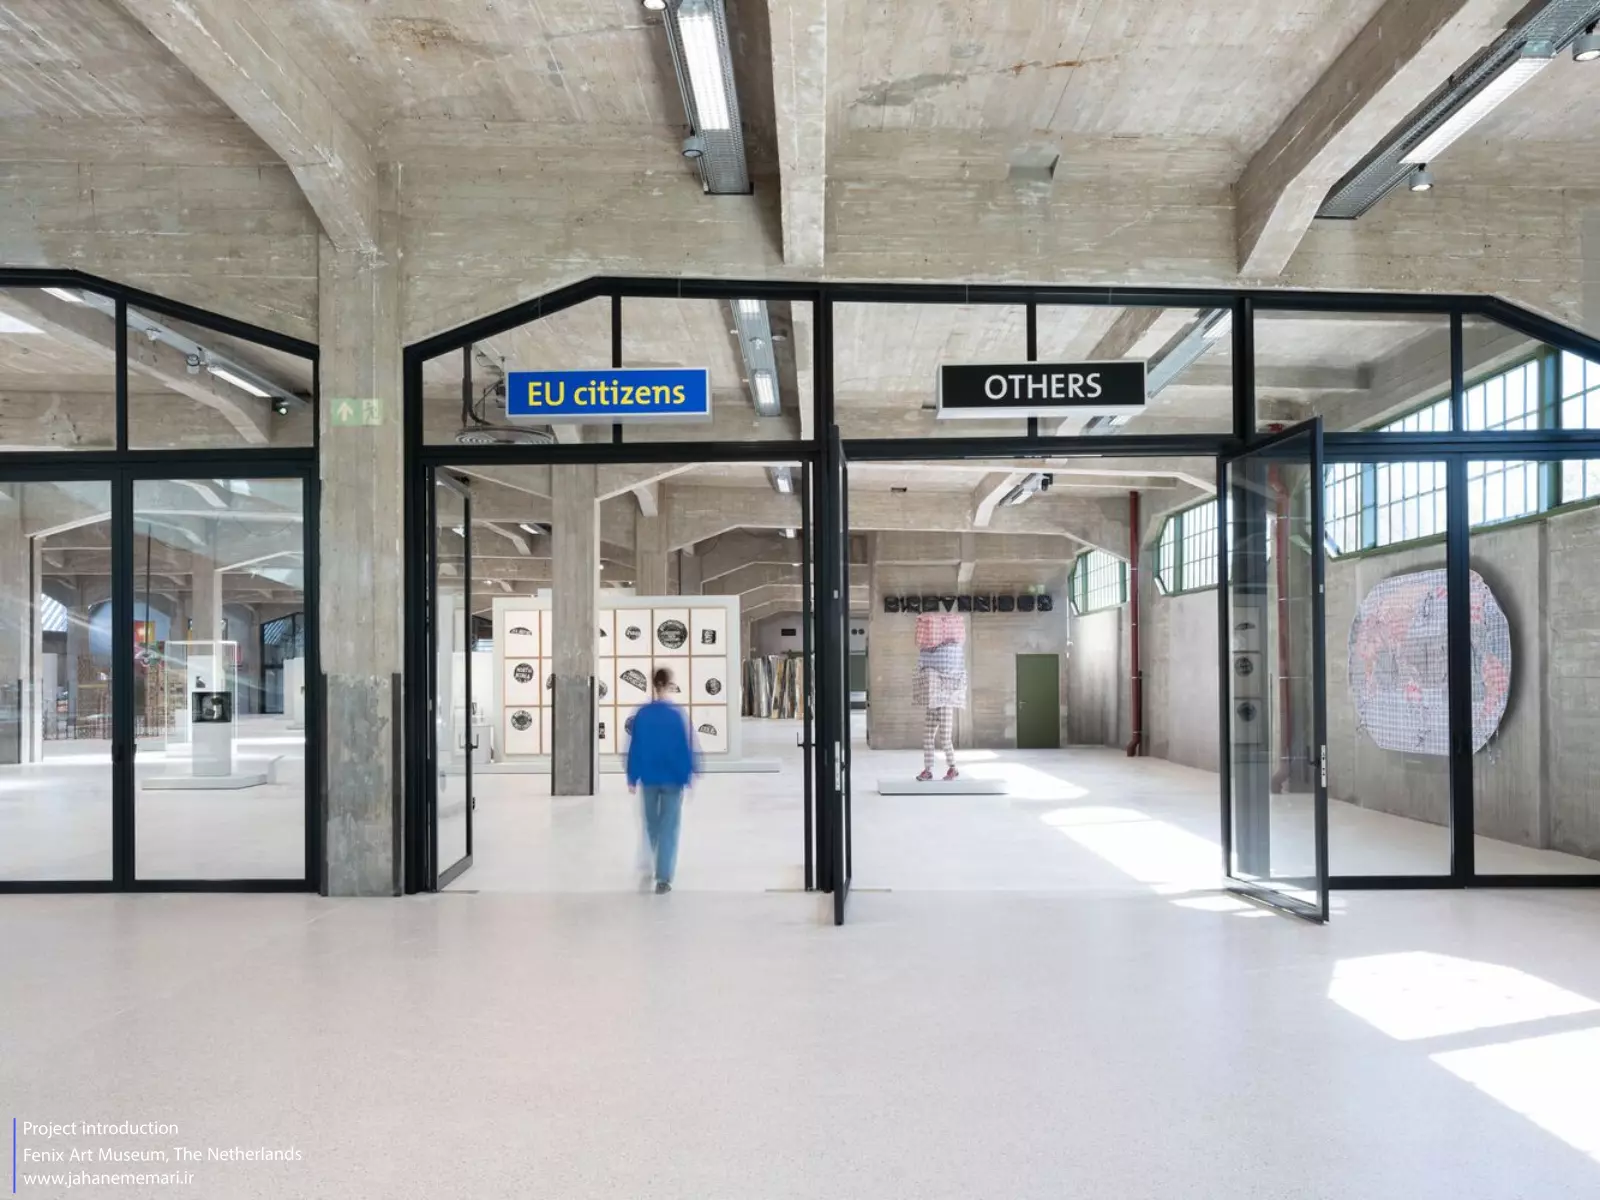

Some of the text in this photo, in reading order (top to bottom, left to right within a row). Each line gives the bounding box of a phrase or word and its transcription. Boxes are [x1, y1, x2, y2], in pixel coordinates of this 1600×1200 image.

[528, 379, 686, 406] EU citizens
[984, 372, 1102, 400] OTHERS
